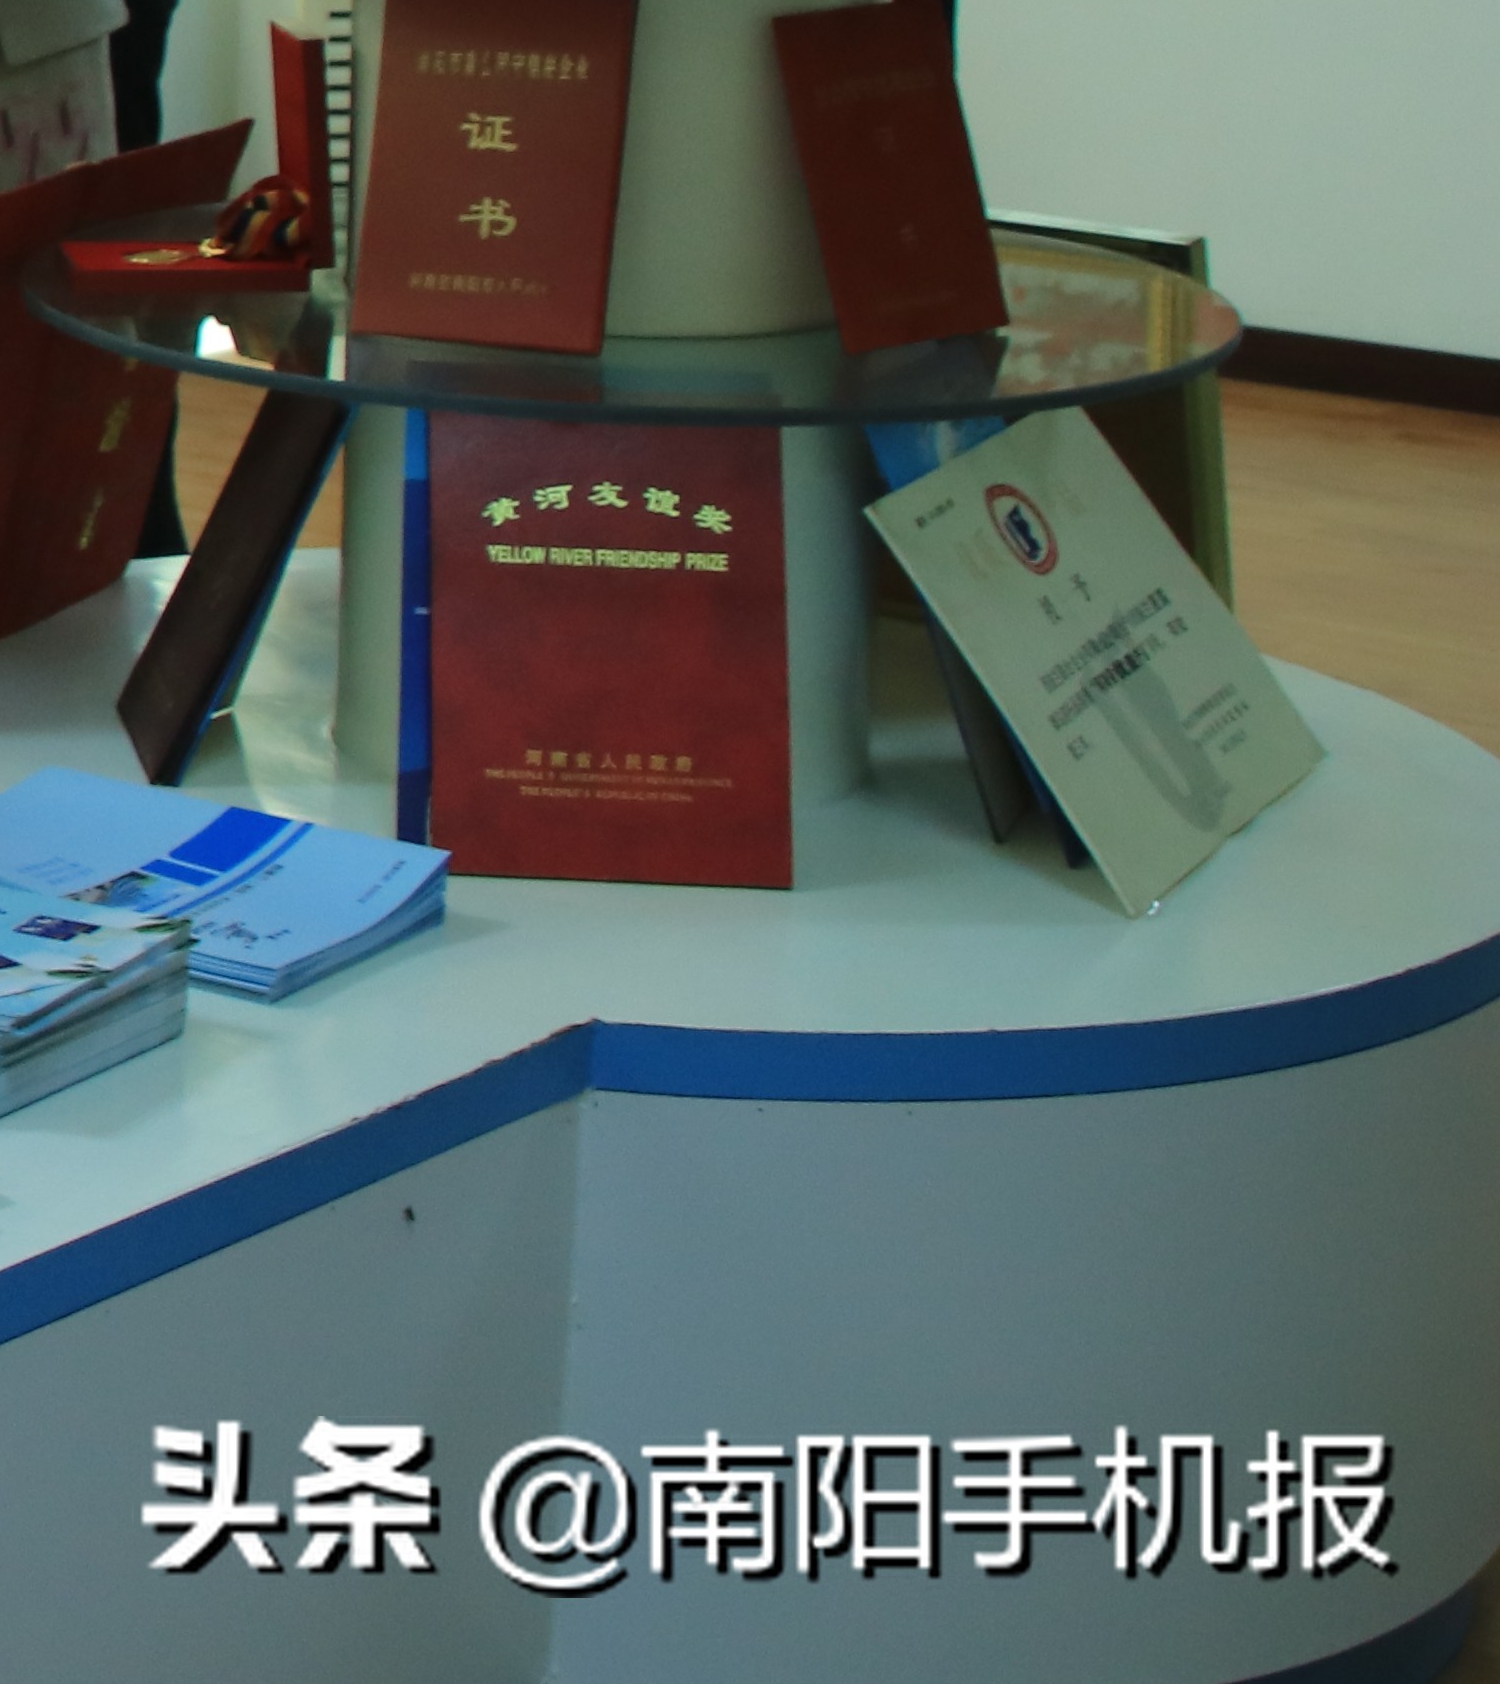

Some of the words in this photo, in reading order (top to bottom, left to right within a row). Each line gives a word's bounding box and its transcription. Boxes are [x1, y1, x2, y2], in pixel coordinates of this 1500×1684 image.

[458, 111, 520, 240] 证书
[486, 544, 547, 565] YELLOW
[549, 547, 593, 567] RIVER
[595, 549, 681, 570] FRIENDSHIP
[684, 552, 729, 572] PRIZE
